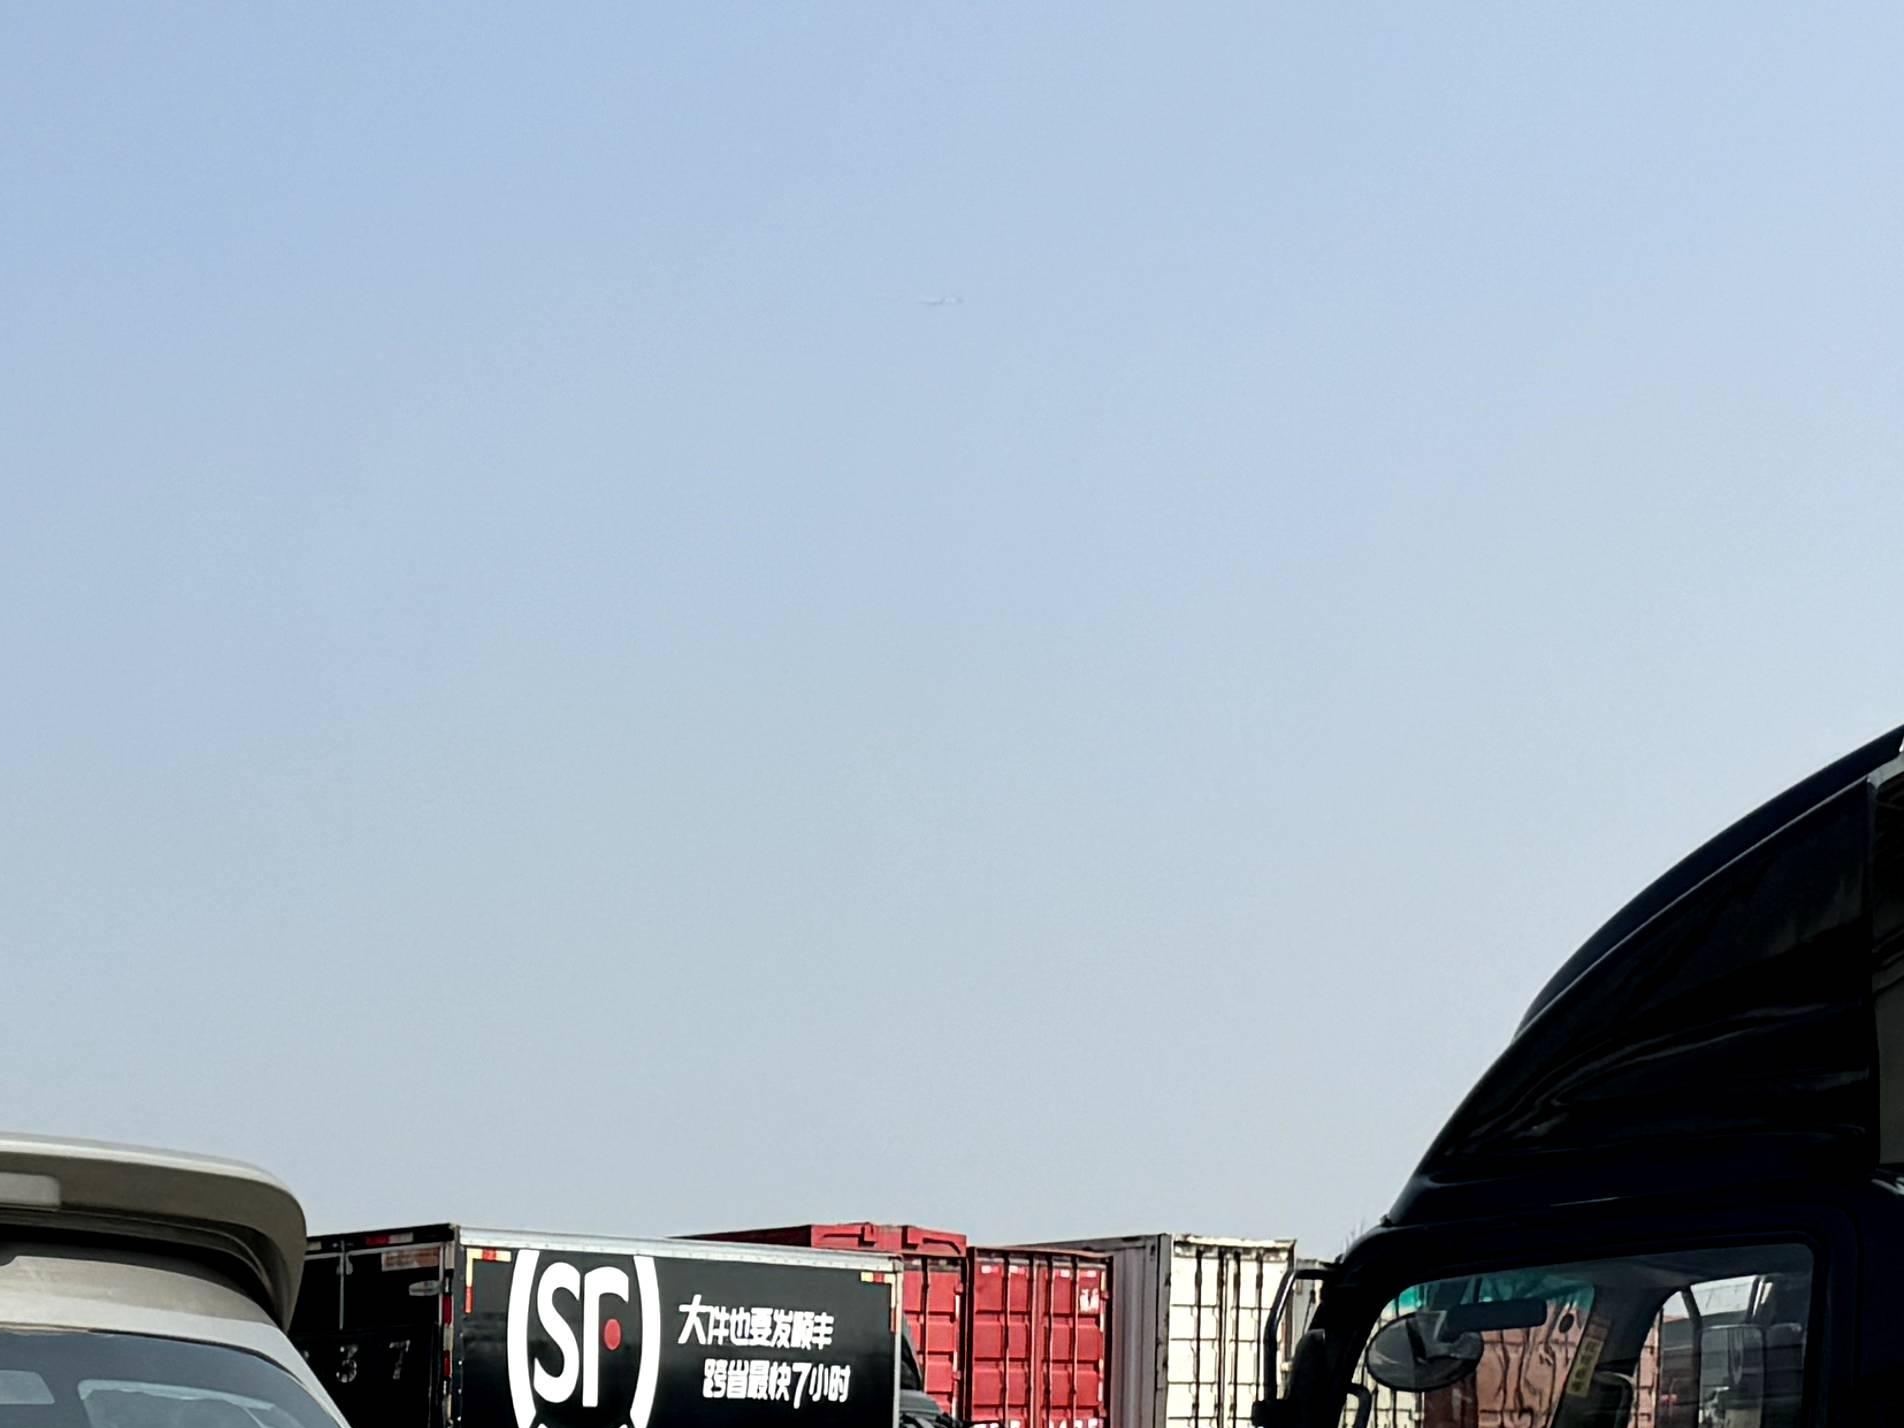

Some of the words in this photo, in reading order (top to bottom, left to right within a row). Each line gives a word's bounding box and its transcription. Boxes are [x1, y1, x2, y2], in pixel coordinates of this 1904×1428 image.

[677, 1294, 835, 1350] 大件也要发顺丰
[702, 1358, 851, 1409] 跨省最快7小时
